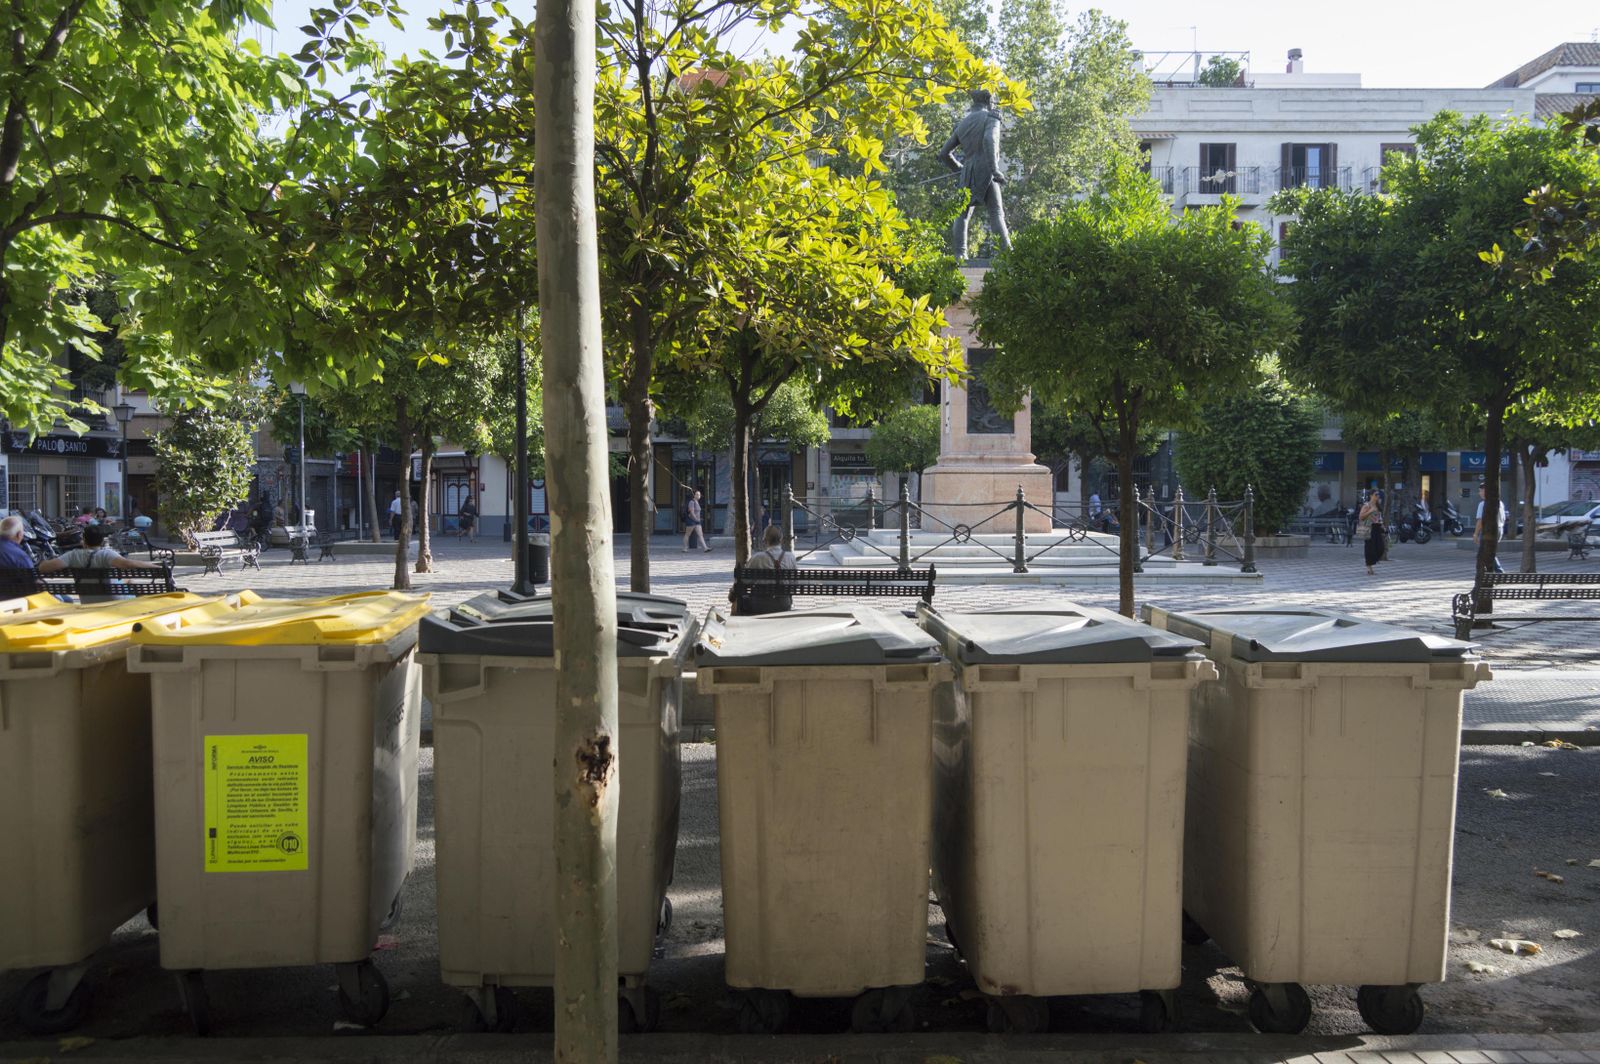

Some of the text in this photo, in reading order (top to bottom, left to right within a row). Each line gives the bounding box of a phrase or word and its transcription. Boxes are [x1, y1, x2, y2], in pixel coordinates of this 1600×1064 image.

[38, 439, 58, 451] PALO
[66, 440, 88, 452] SANTO
[284, 838, 298, 850] 010
